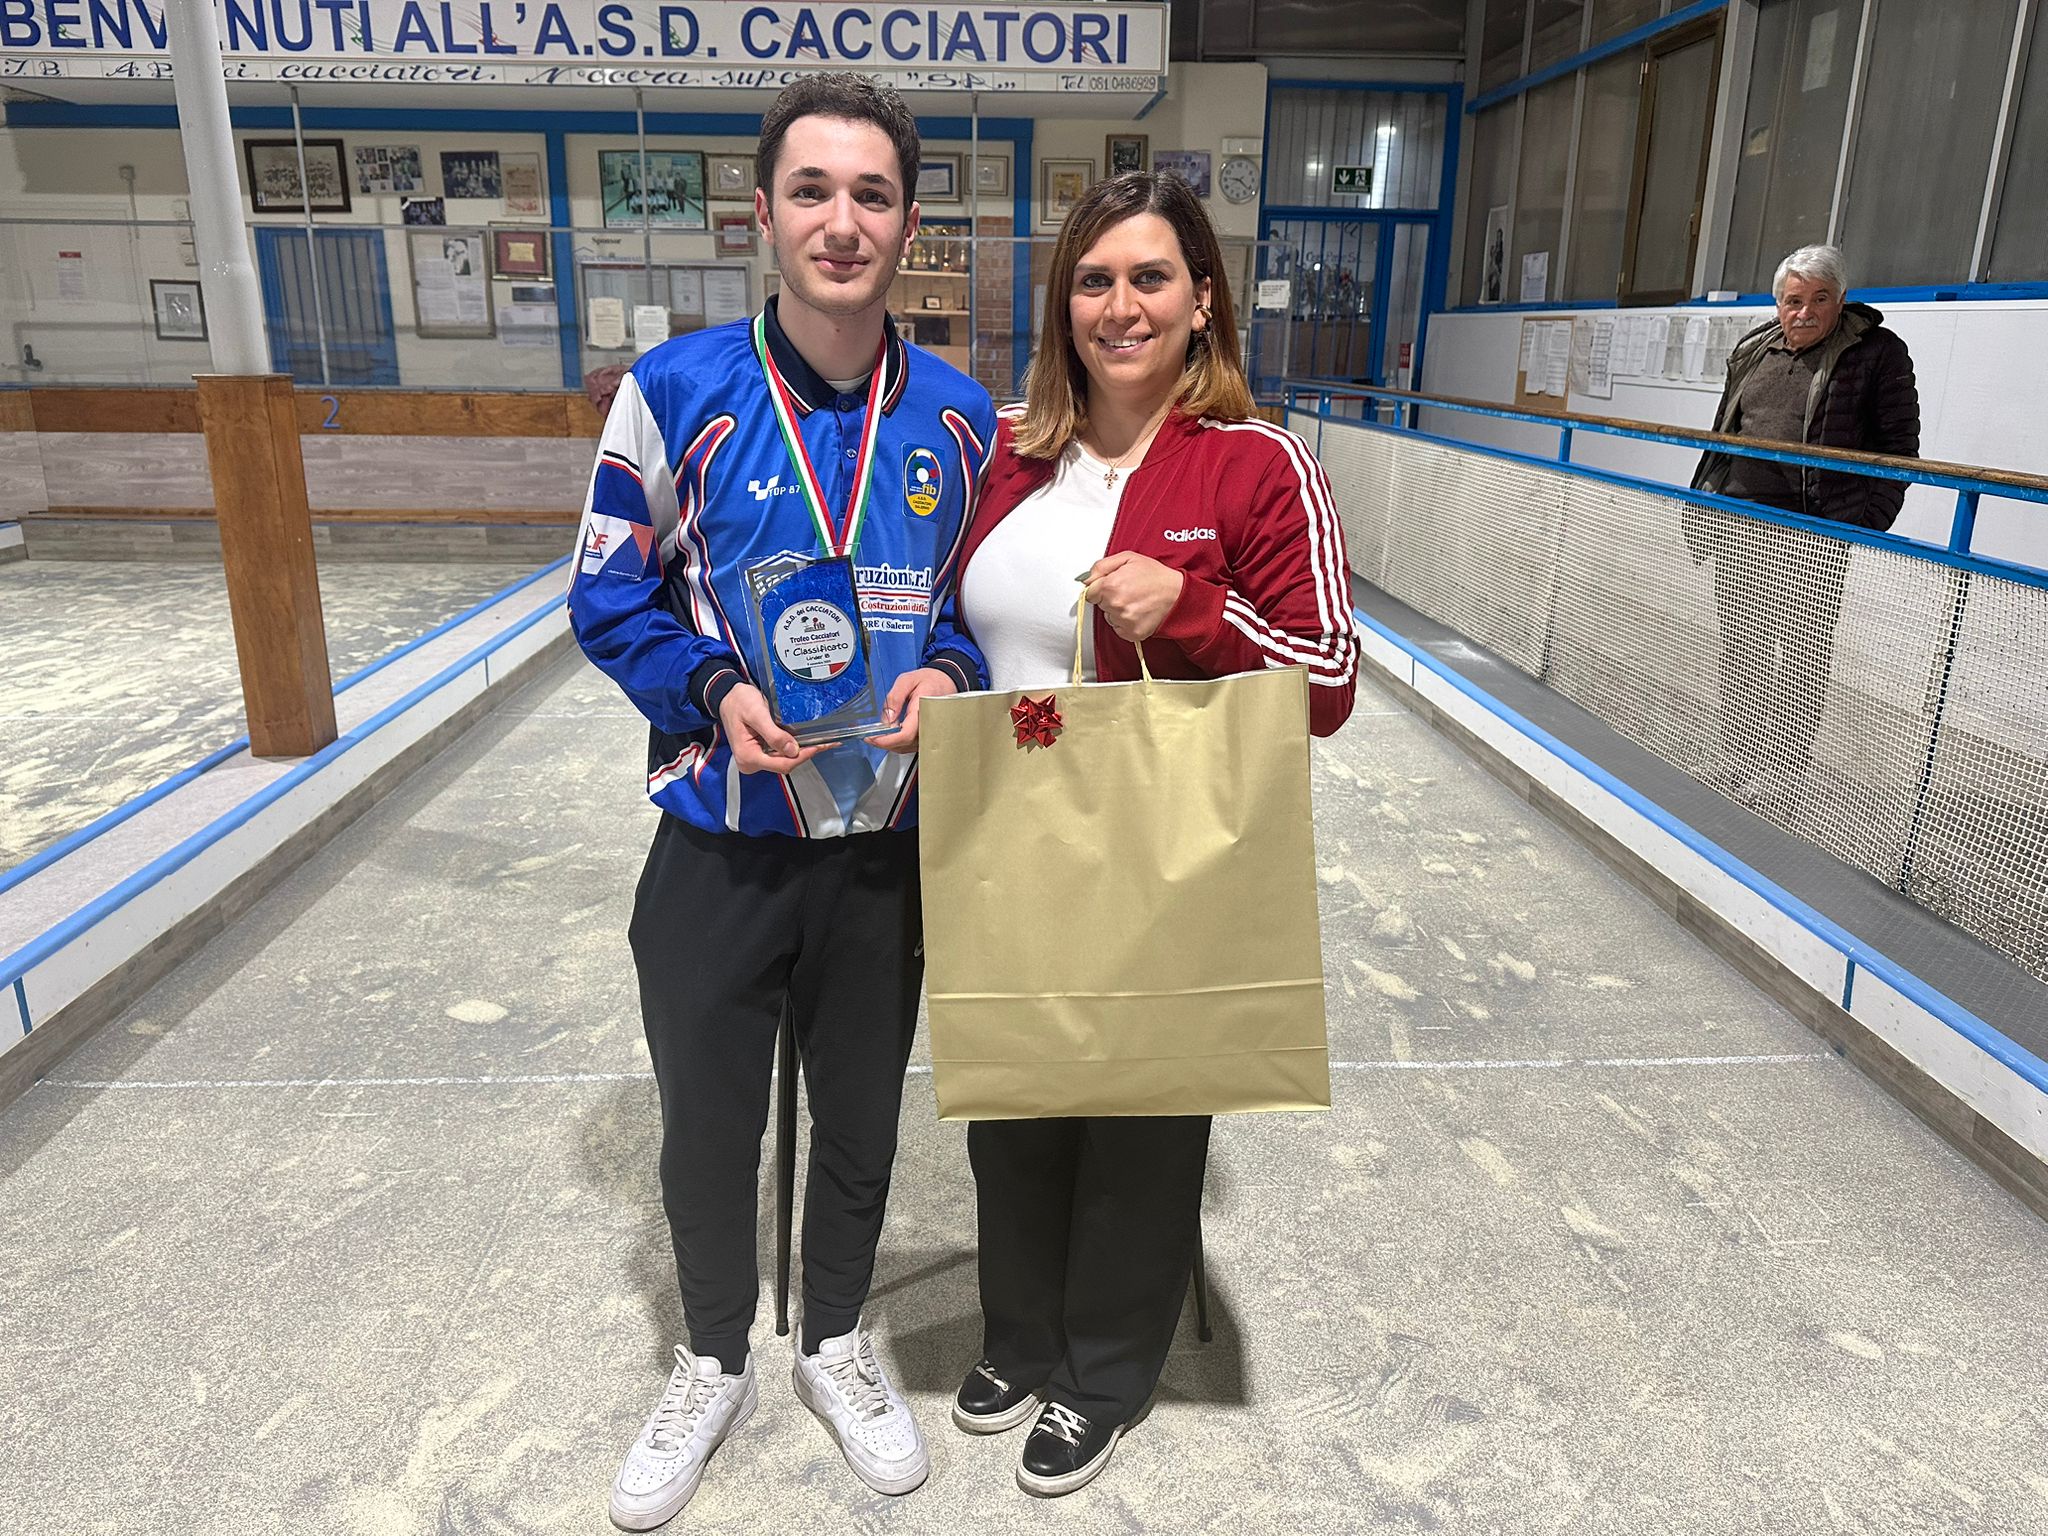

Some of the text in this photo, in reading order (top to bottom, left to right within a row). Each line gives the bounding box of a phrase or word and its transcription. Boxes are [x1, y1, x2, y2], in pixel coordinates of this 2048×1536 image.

[0, 0, 374, 52] BENVNUTI
[740, 7, 1128, 64] CACCIATORI
[320, 395, 343, 429] 2
[1163, 526, 1217, 542] adidas
[861, 600, 911, 612] Costruzioni
[806, 606, 842, 623] CACCIATORI
[811, 631, 840, 641] Cacciatori
[793, 642, 849, 657] Classificato
